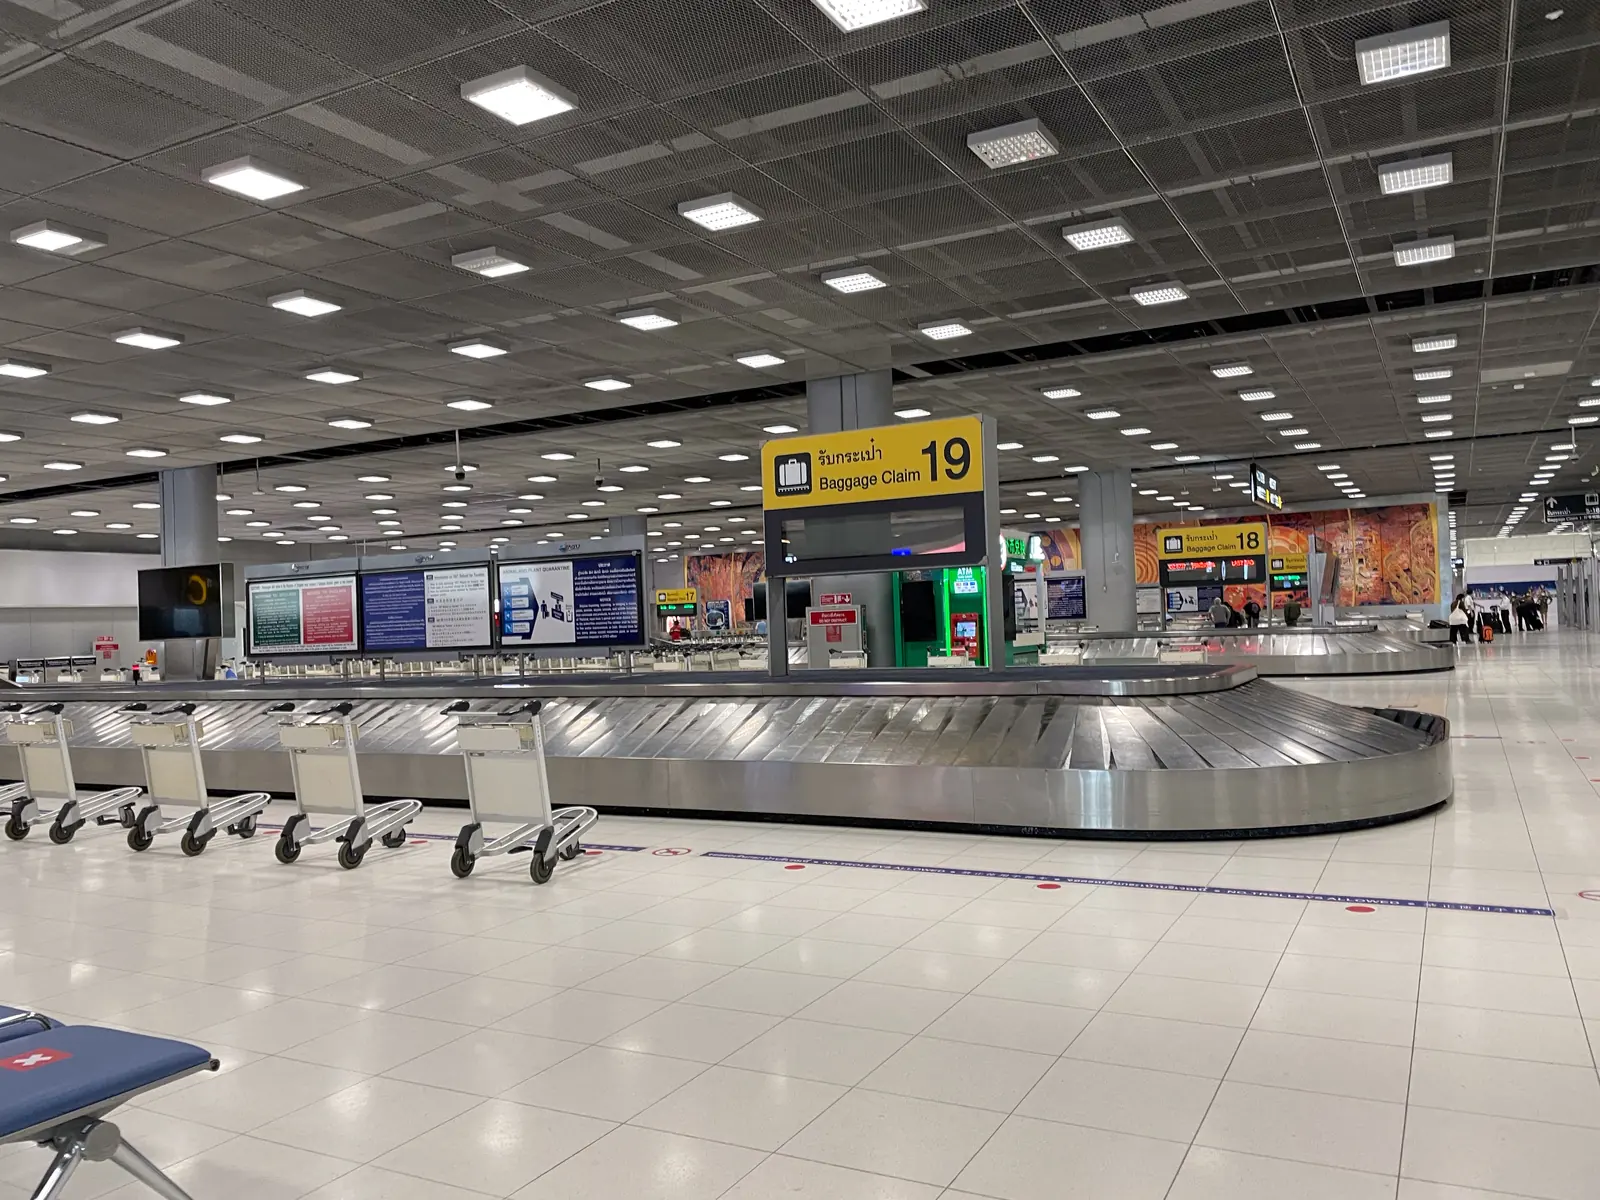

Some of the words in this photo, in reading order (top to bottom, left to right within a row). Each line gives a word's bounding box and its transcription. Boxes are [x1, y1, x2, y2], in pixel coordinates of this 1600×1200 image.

[818, 438, 882, 466] รับกระเป๋า
[921, 437, 971, 482] 19
[819, 474, 877, 491] Baggage
[882, 469, 921, 485] Claim
[1236, 531, 1260, 550] 18
[1186, 545, 1215, 553] Baggage
[957, 567, 973, 576] ATM
[686, 591, 695, 601] 17
[1252, 891, 1324, 900] TROLLEYS
[1327, 897, 1400, 905] ALLOWED
